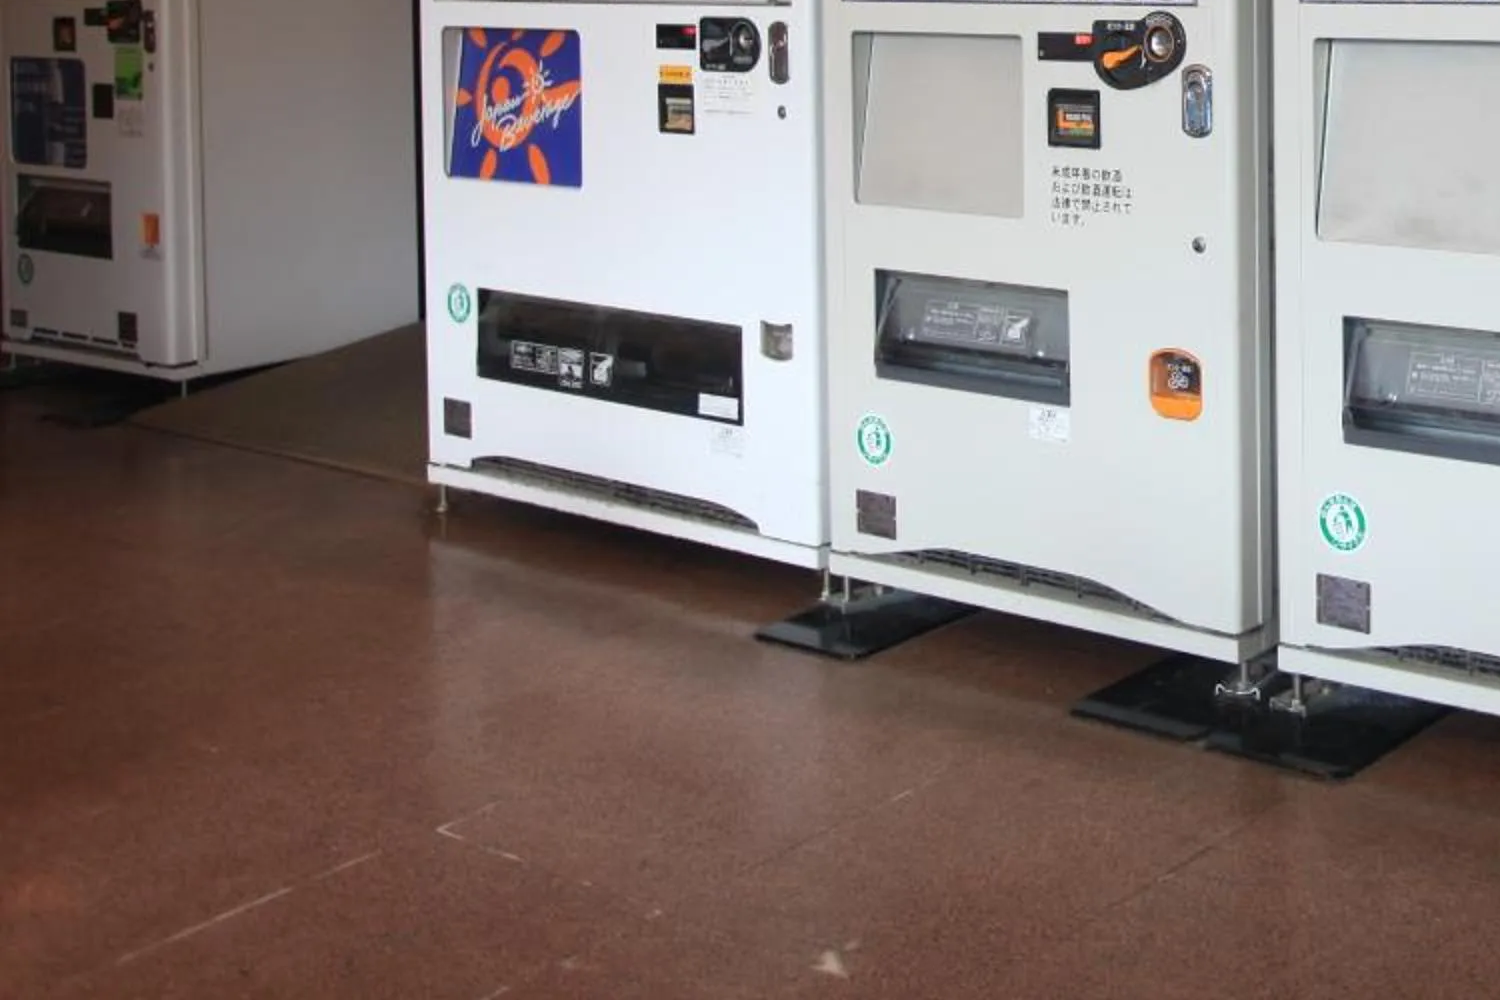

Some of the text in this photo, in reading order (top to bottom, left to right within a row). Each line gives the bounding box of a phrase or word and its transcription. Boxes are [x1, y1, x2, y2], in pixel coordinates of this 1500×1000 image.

[1052, 165, 1123, 182] 未成年者の飲酒
[1051, 213, 1086, 226] います。
